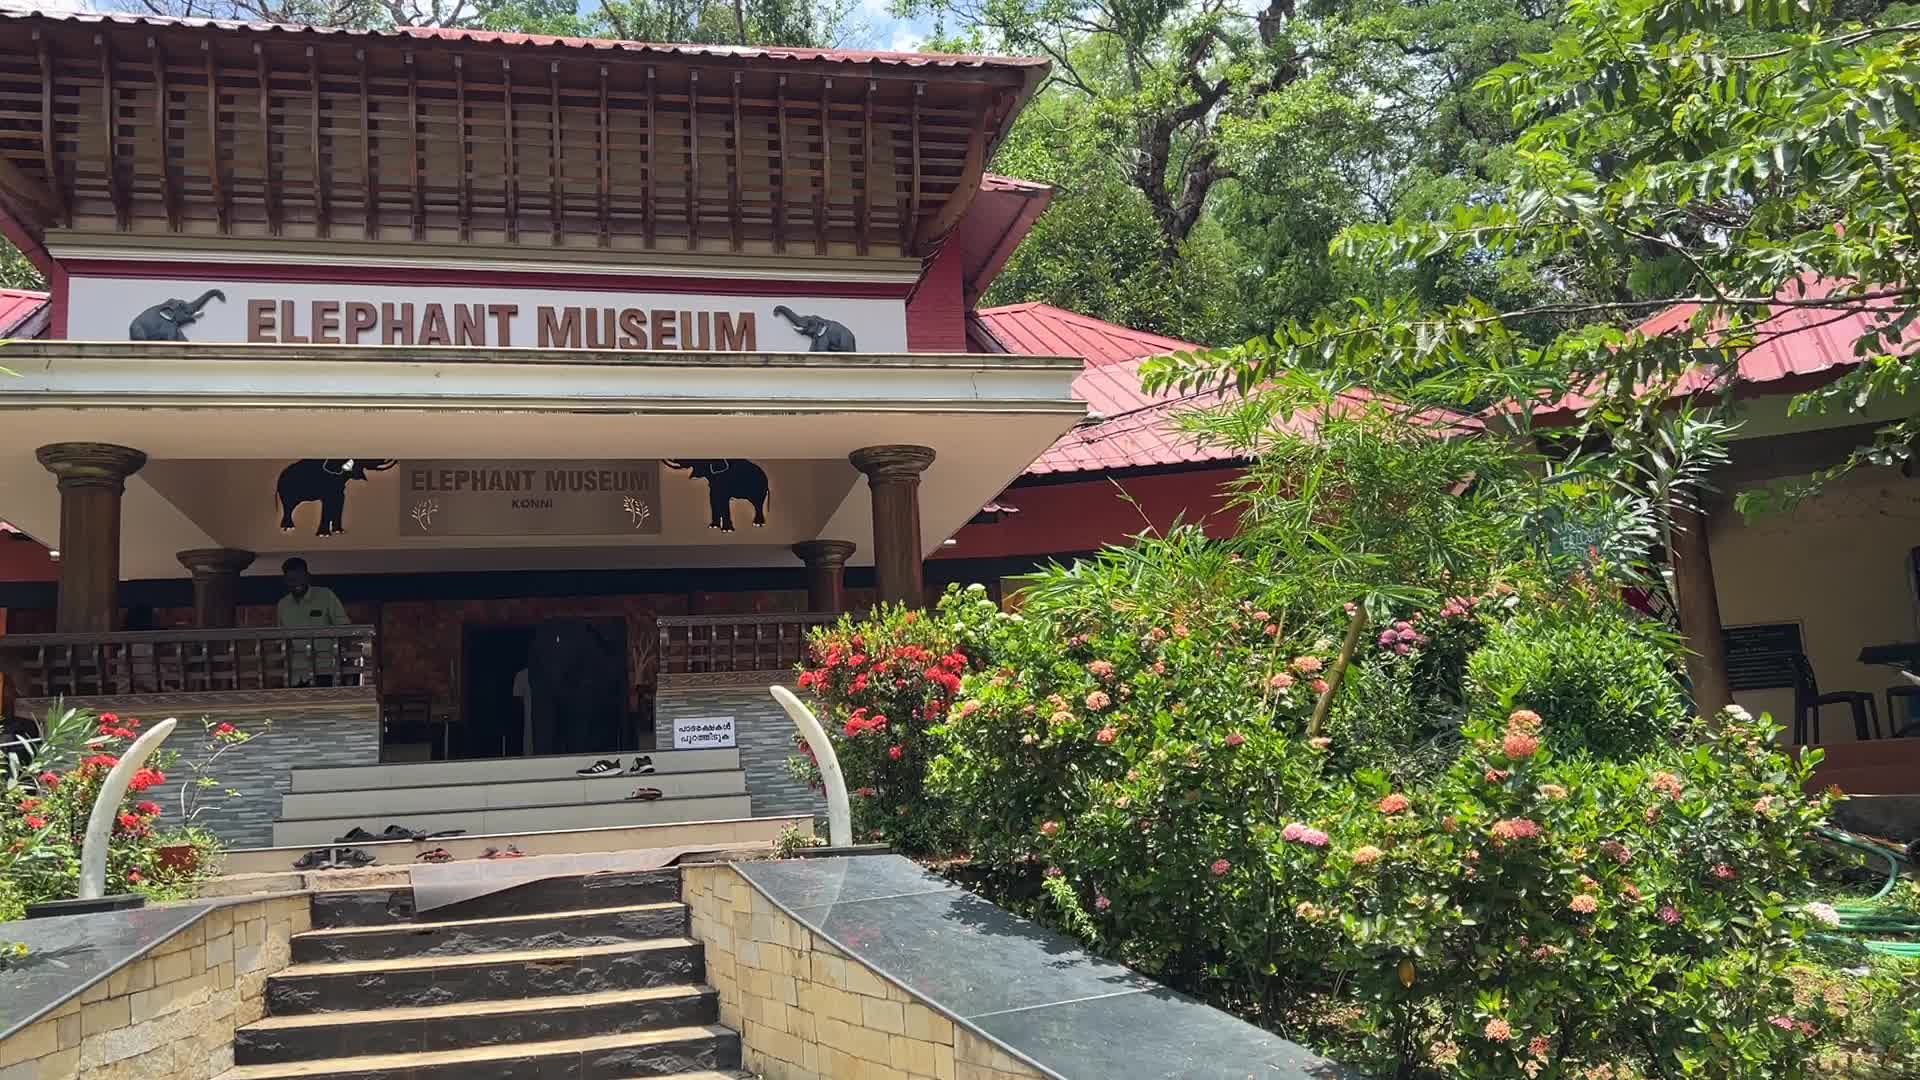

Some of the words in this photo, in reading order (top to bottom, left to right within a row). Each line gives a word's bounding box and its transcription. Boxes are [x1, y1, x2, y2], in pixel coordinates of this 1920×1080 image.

[248, 300, 518, 347] ELEPHANT
[537, 306, 757, 351] MUSEUM
[411, 470, 536, 492] ELEPHANT
[545, 470, 650, 492] MUSEUM
[511, 498, 553, 509] KONNI
